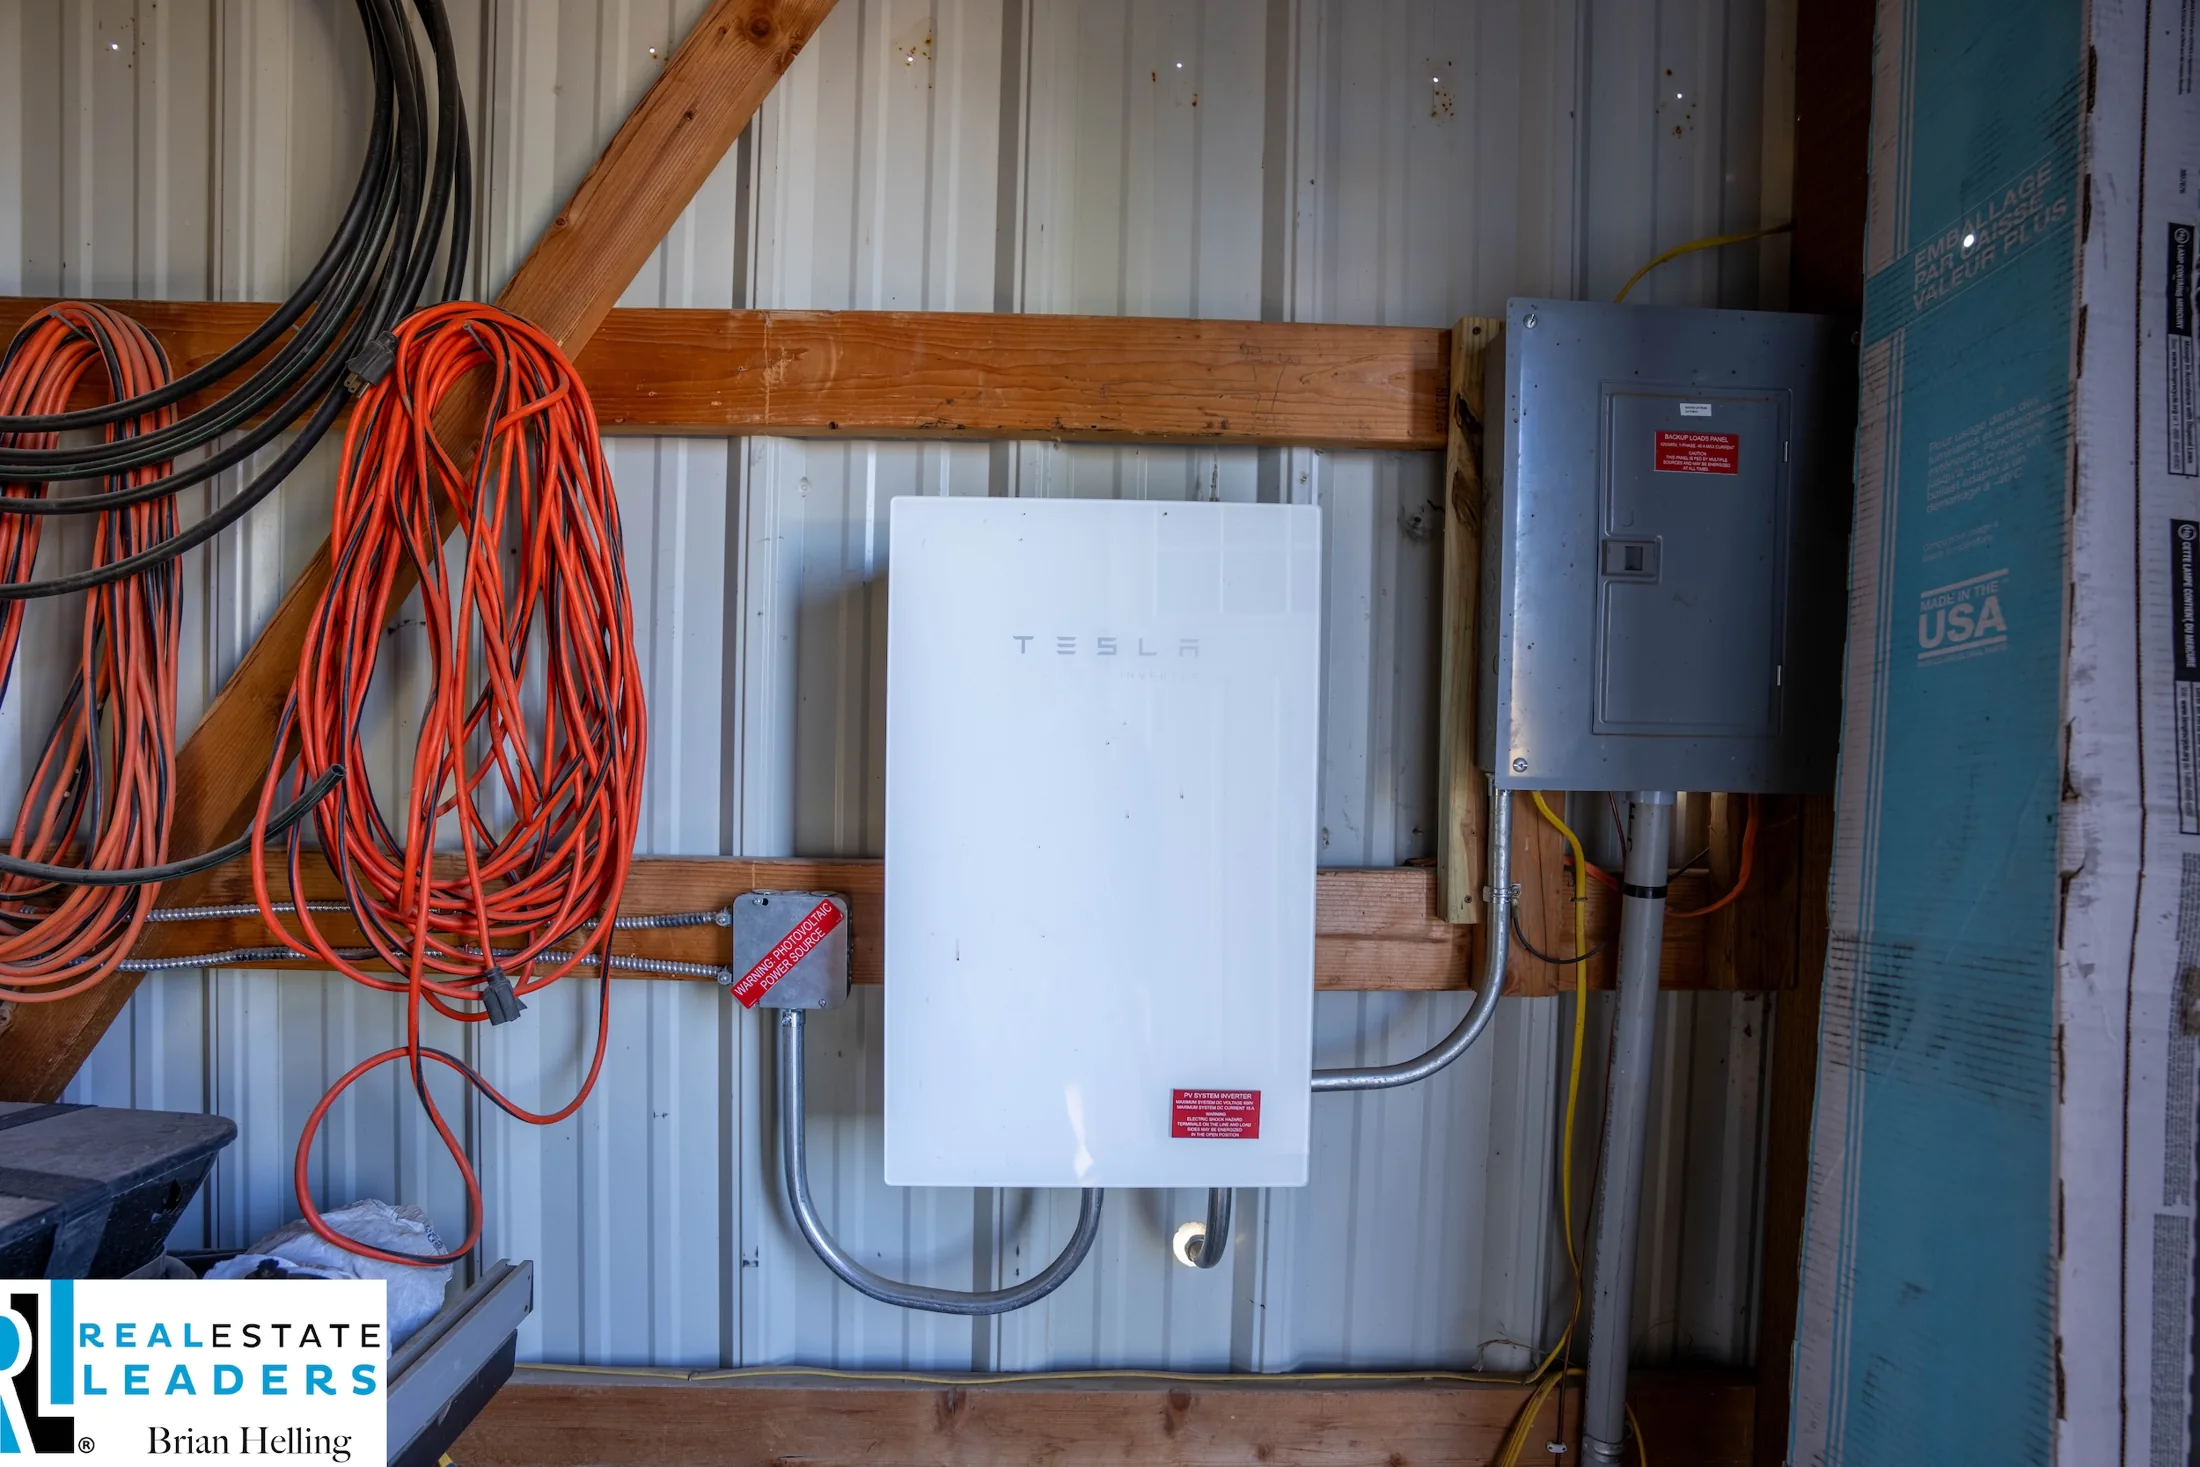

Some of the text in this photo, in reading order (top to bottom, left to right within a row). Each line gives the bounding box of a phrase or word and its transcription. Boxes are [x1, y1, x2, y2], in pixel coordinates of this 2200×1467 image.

[1915, 160, 2051, 272] EMBALLAGE
[1913, 197, 2067, 310] VALEUR PLUS
[1915, 188, 2044, 291] PAR CAISSE
[2175, 245, 2185, 329] LAMP CONTAINS MERCURY
[1929, 436, 1952, 452] Pour
[1955, 422, 1986, 441] usage
[1989, 407, 2015, 426] dans
[2026, 435, 2041, 448] un
[2181, 542, 2191, 562] CETTE
[1920, 581, 1999, 611] MADE IN THE
[2183, 564, 2192, 587] LAMPE
[1919, 595, 2008, 648] USA
[2184, 623, 2194, 633] DU
[1012, 635, 1200, 657] TESLA
[2185, 635, 2196, 668] MERCURE
[734, 903, 832, 996] WARNING: PHOTOVOLTAIC
[760, 928, 825, 990] POWER SOURCE
